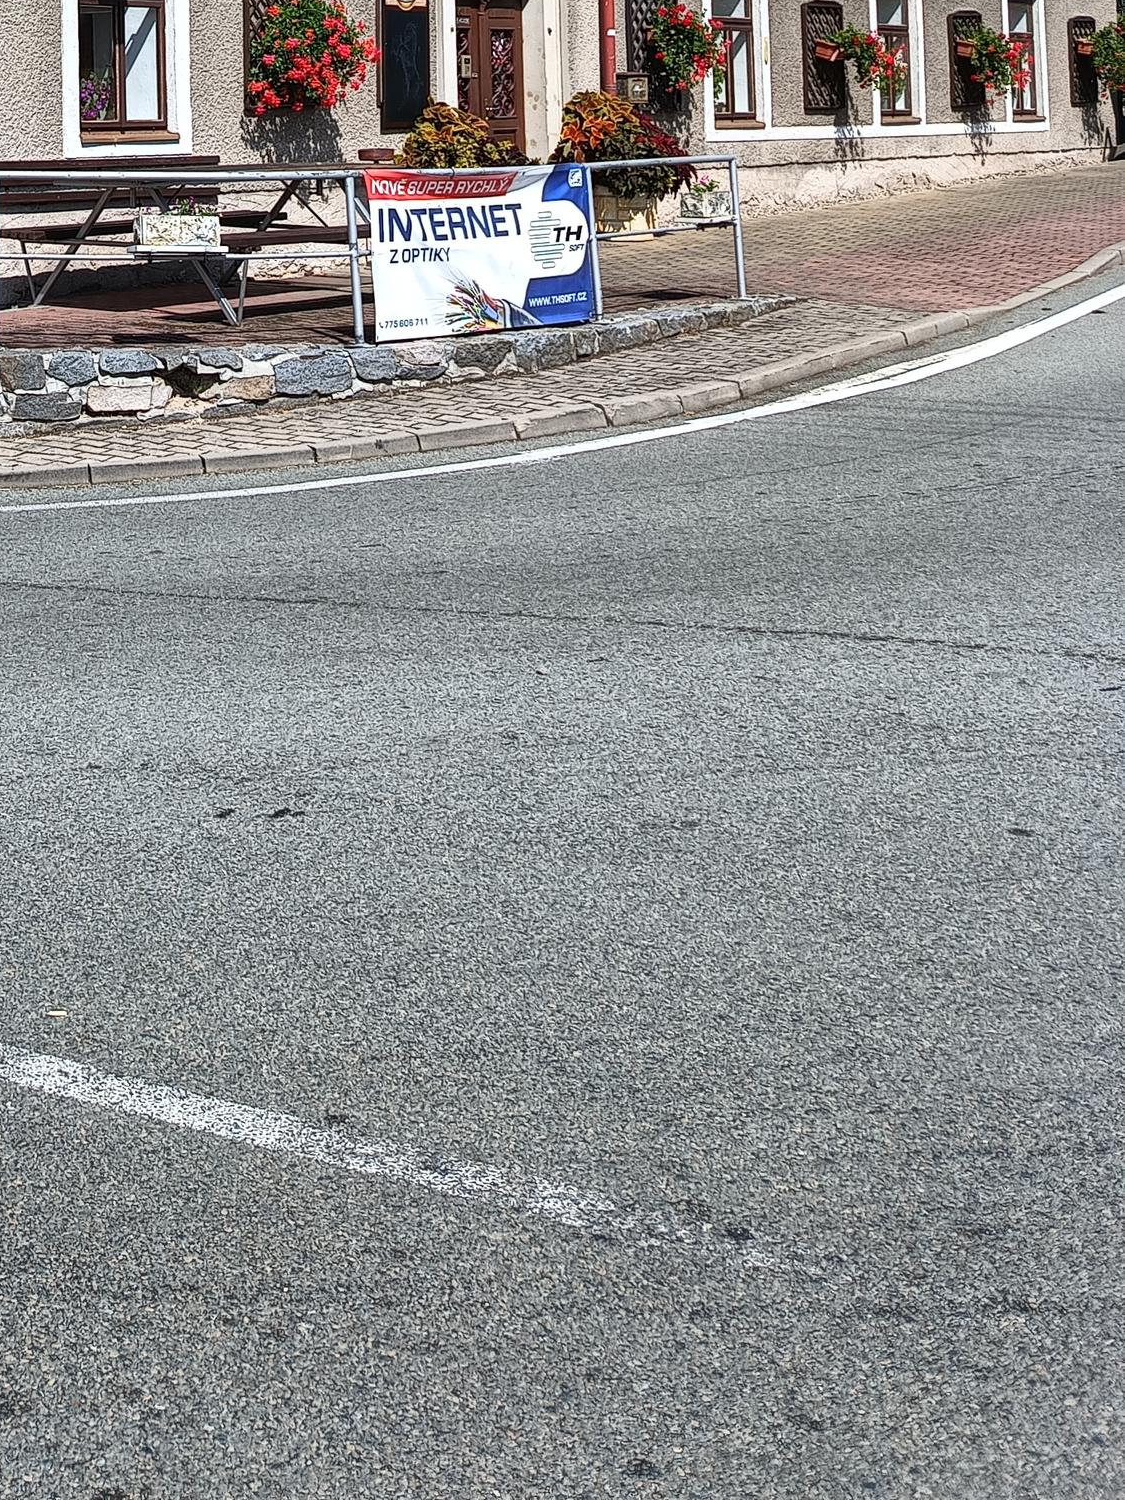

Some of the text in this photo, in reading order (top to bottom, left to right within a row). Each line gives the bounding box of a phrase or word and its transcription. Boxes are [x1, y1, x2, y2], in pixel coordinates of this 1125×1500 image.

[407, 179, 455, 195] SUPER
[455, 177, 509, 194] RYCHLÝ
[378, 204, 522, 243] INTERNET
[553, 225, 583, 242] TH
[389, 247, 451, 264] Z OPTIKY
[528, 291, 588, 308] WWW.THSOFT.CZ
